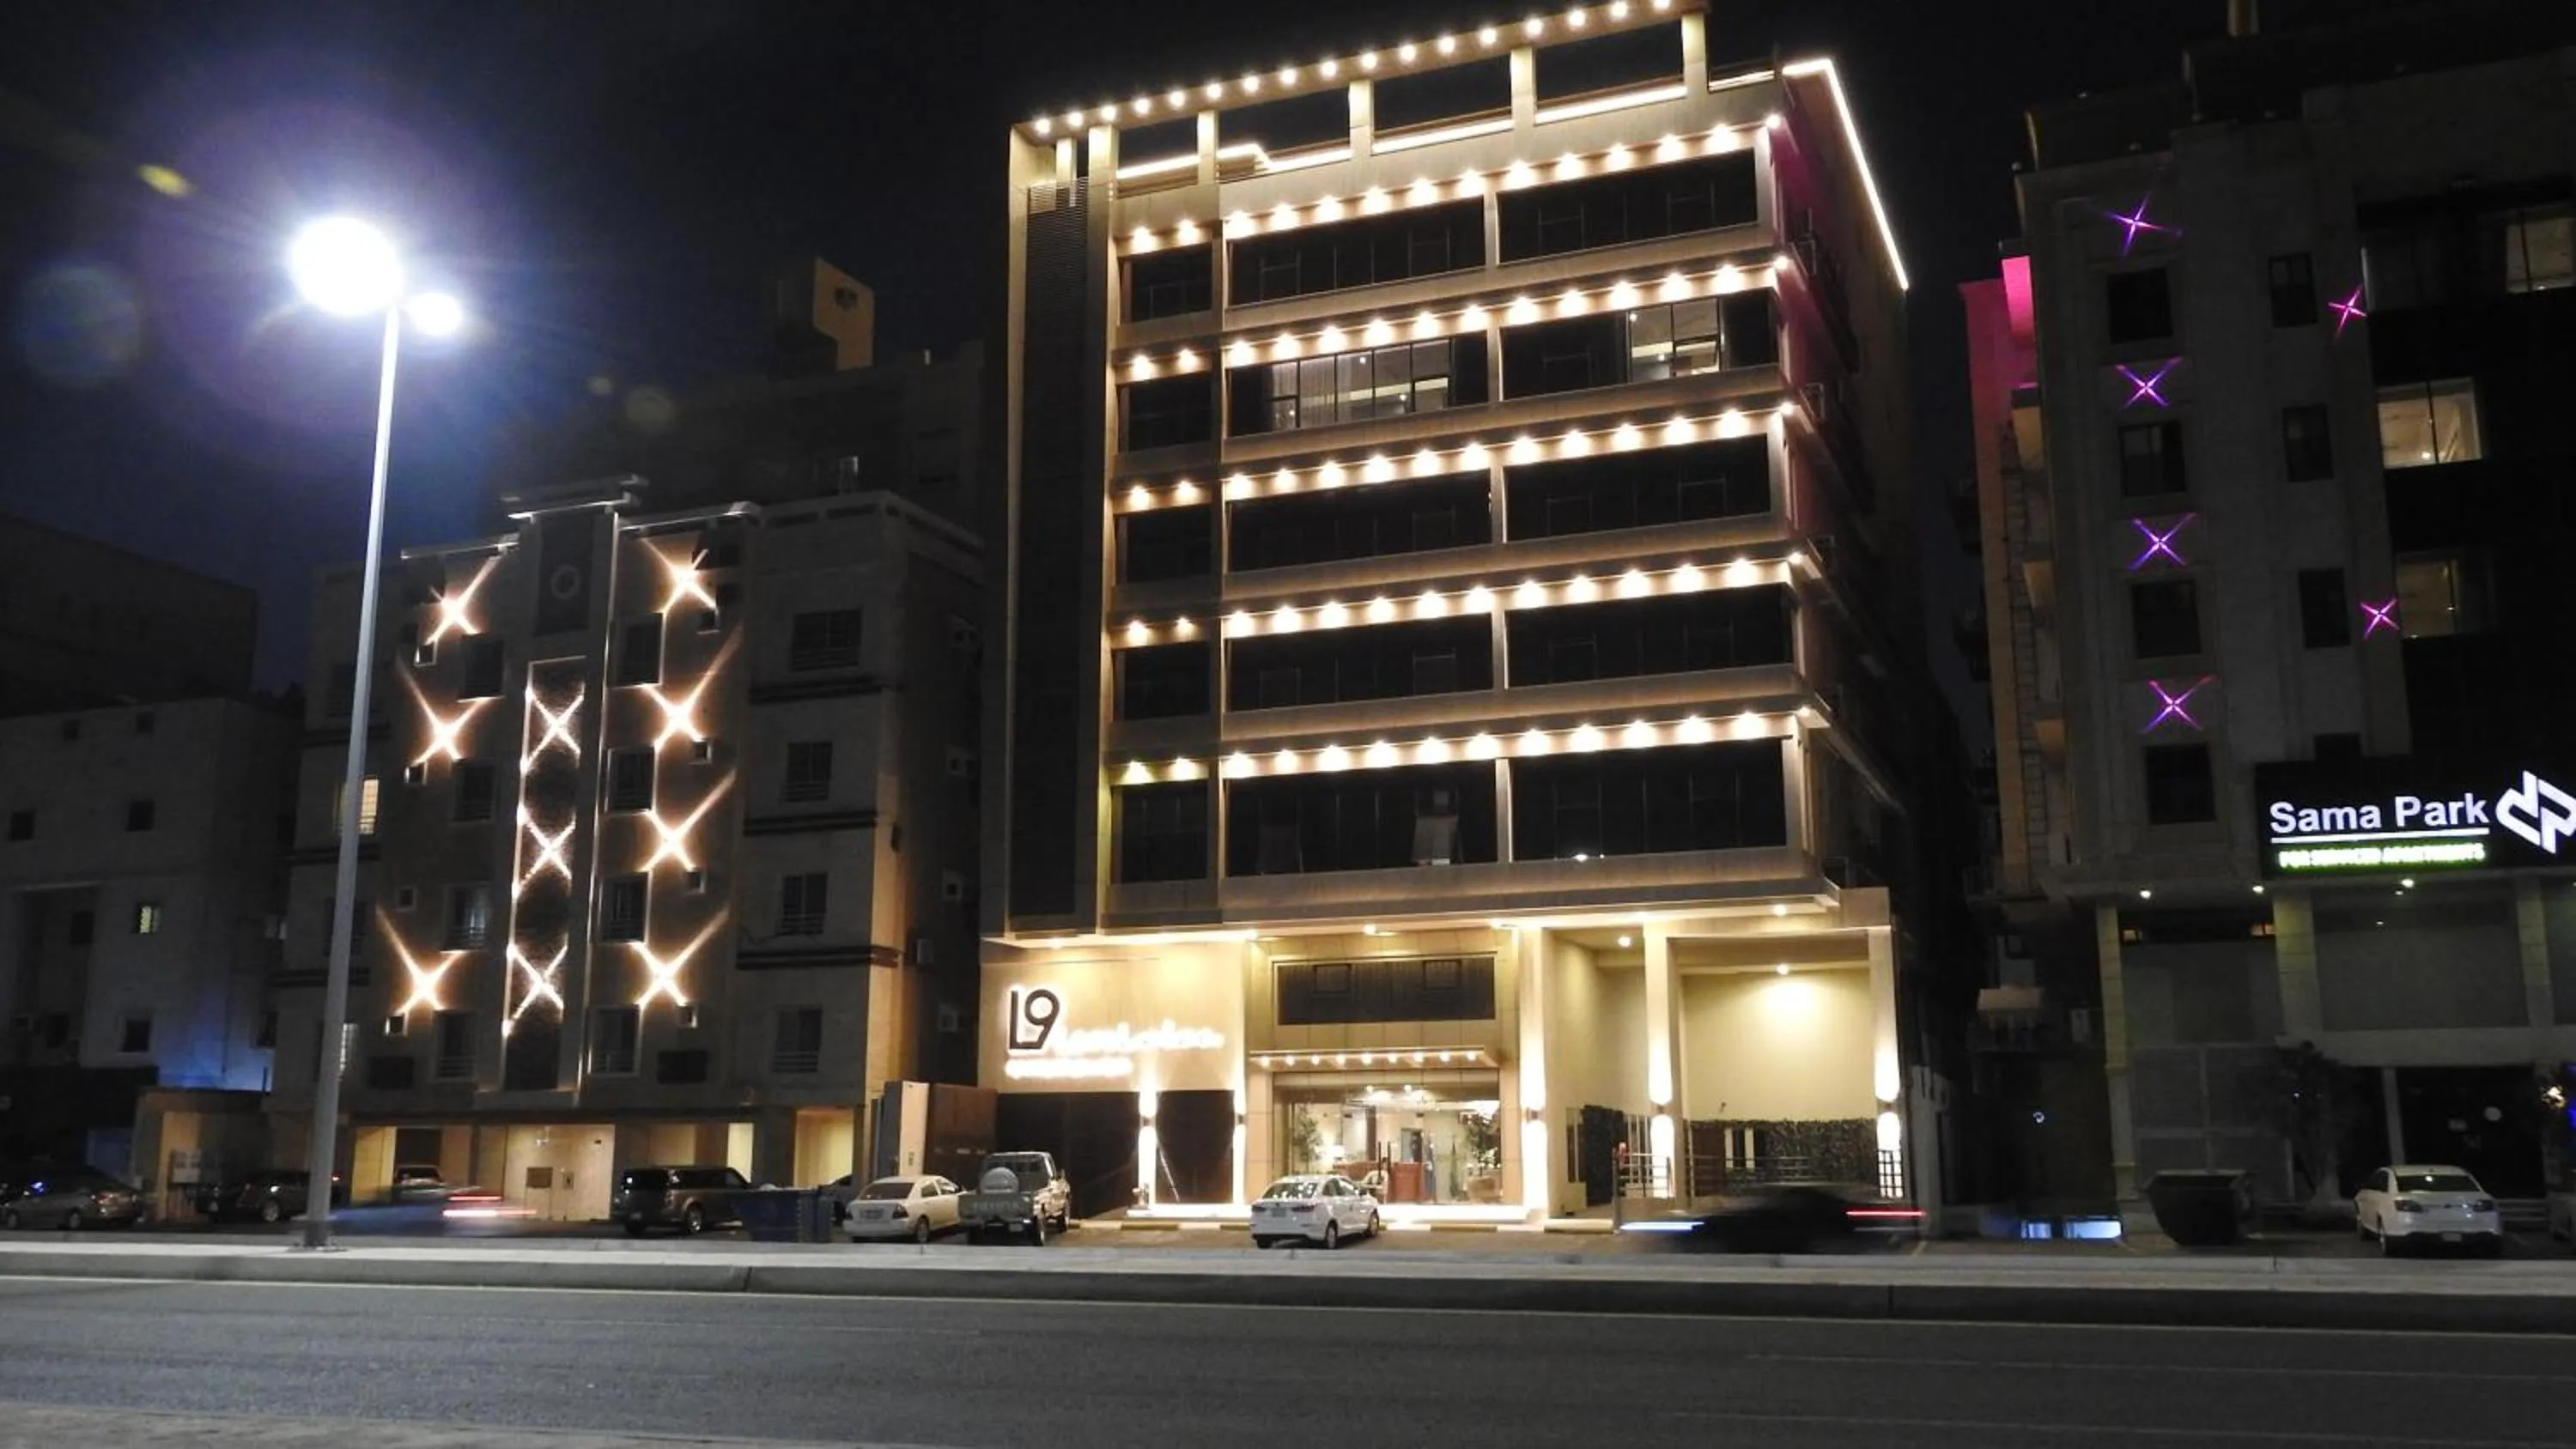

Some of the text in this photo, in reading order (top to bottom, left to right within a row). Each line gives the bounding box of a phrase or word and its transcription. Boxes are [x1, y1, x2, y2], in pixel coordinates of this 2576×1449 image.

[2270, 793, 2490, 834] Sama Park
[1010, 989, 1060, 1050] L9
